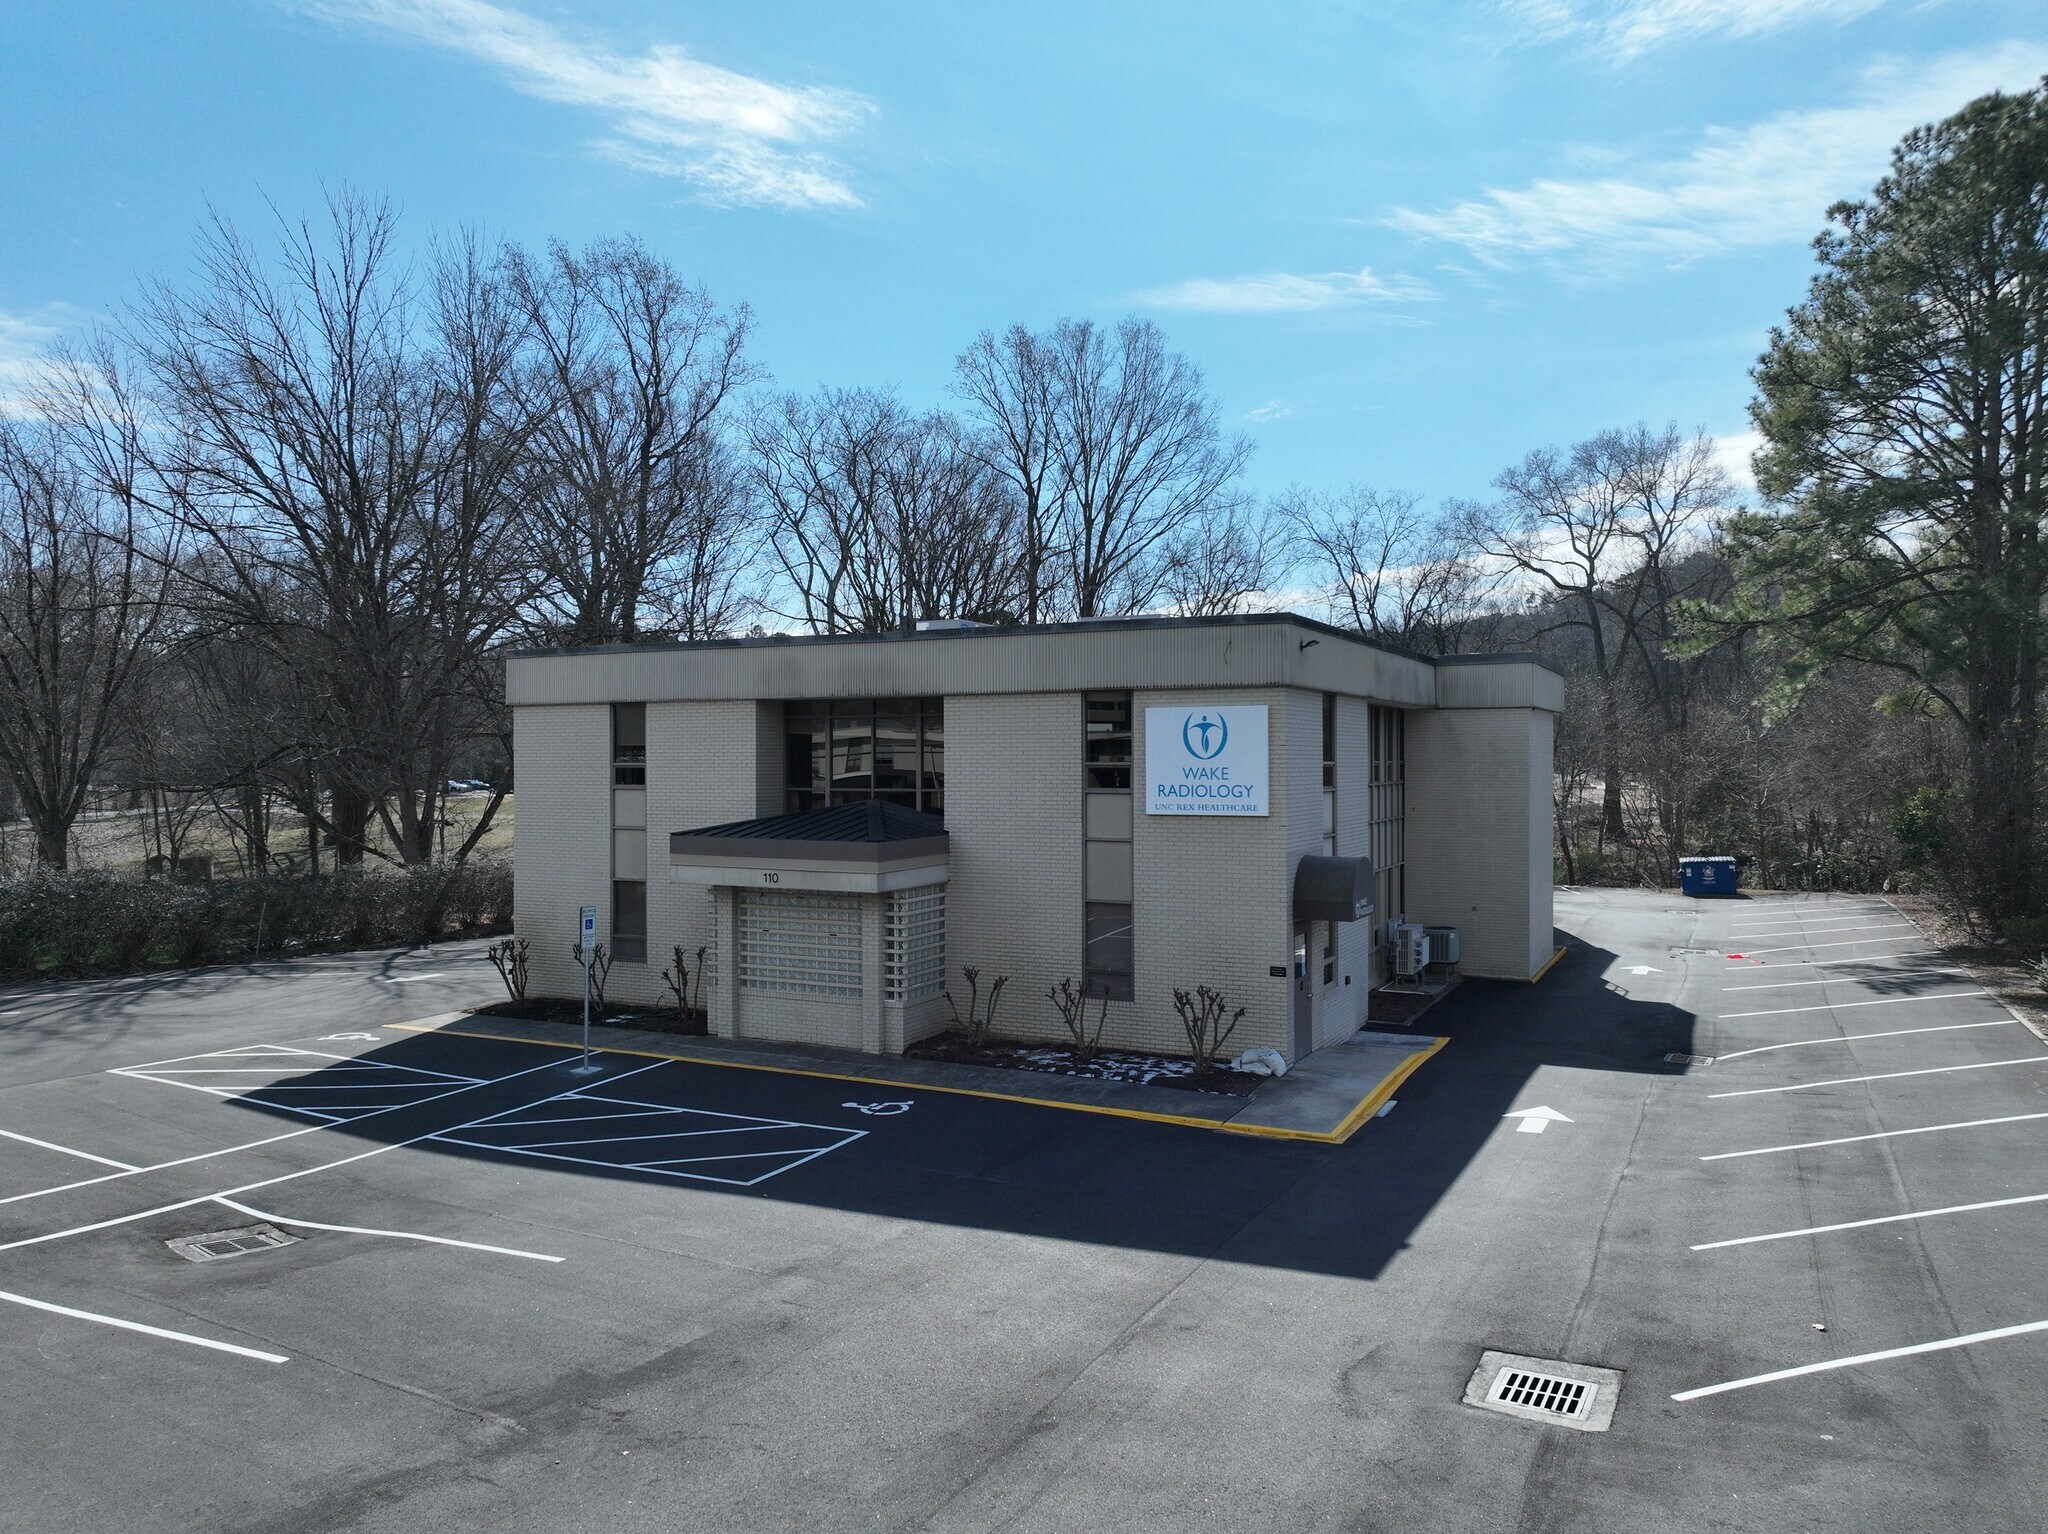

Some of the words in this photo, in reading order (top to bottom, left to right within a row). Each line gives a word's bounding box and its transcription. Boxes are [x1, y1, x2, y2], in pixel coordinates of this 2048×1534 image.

[1182, 767, 1229, 780] WAKE
[1158, 784, 1254, 798] RADIOLOGY
[1155, 803, 1174, 811] UNC
[1176, 803, 1195, 811] REX
[1197, 804, 1259, 812] HEALTHCARE
[763, 872, 779, 883] 110
